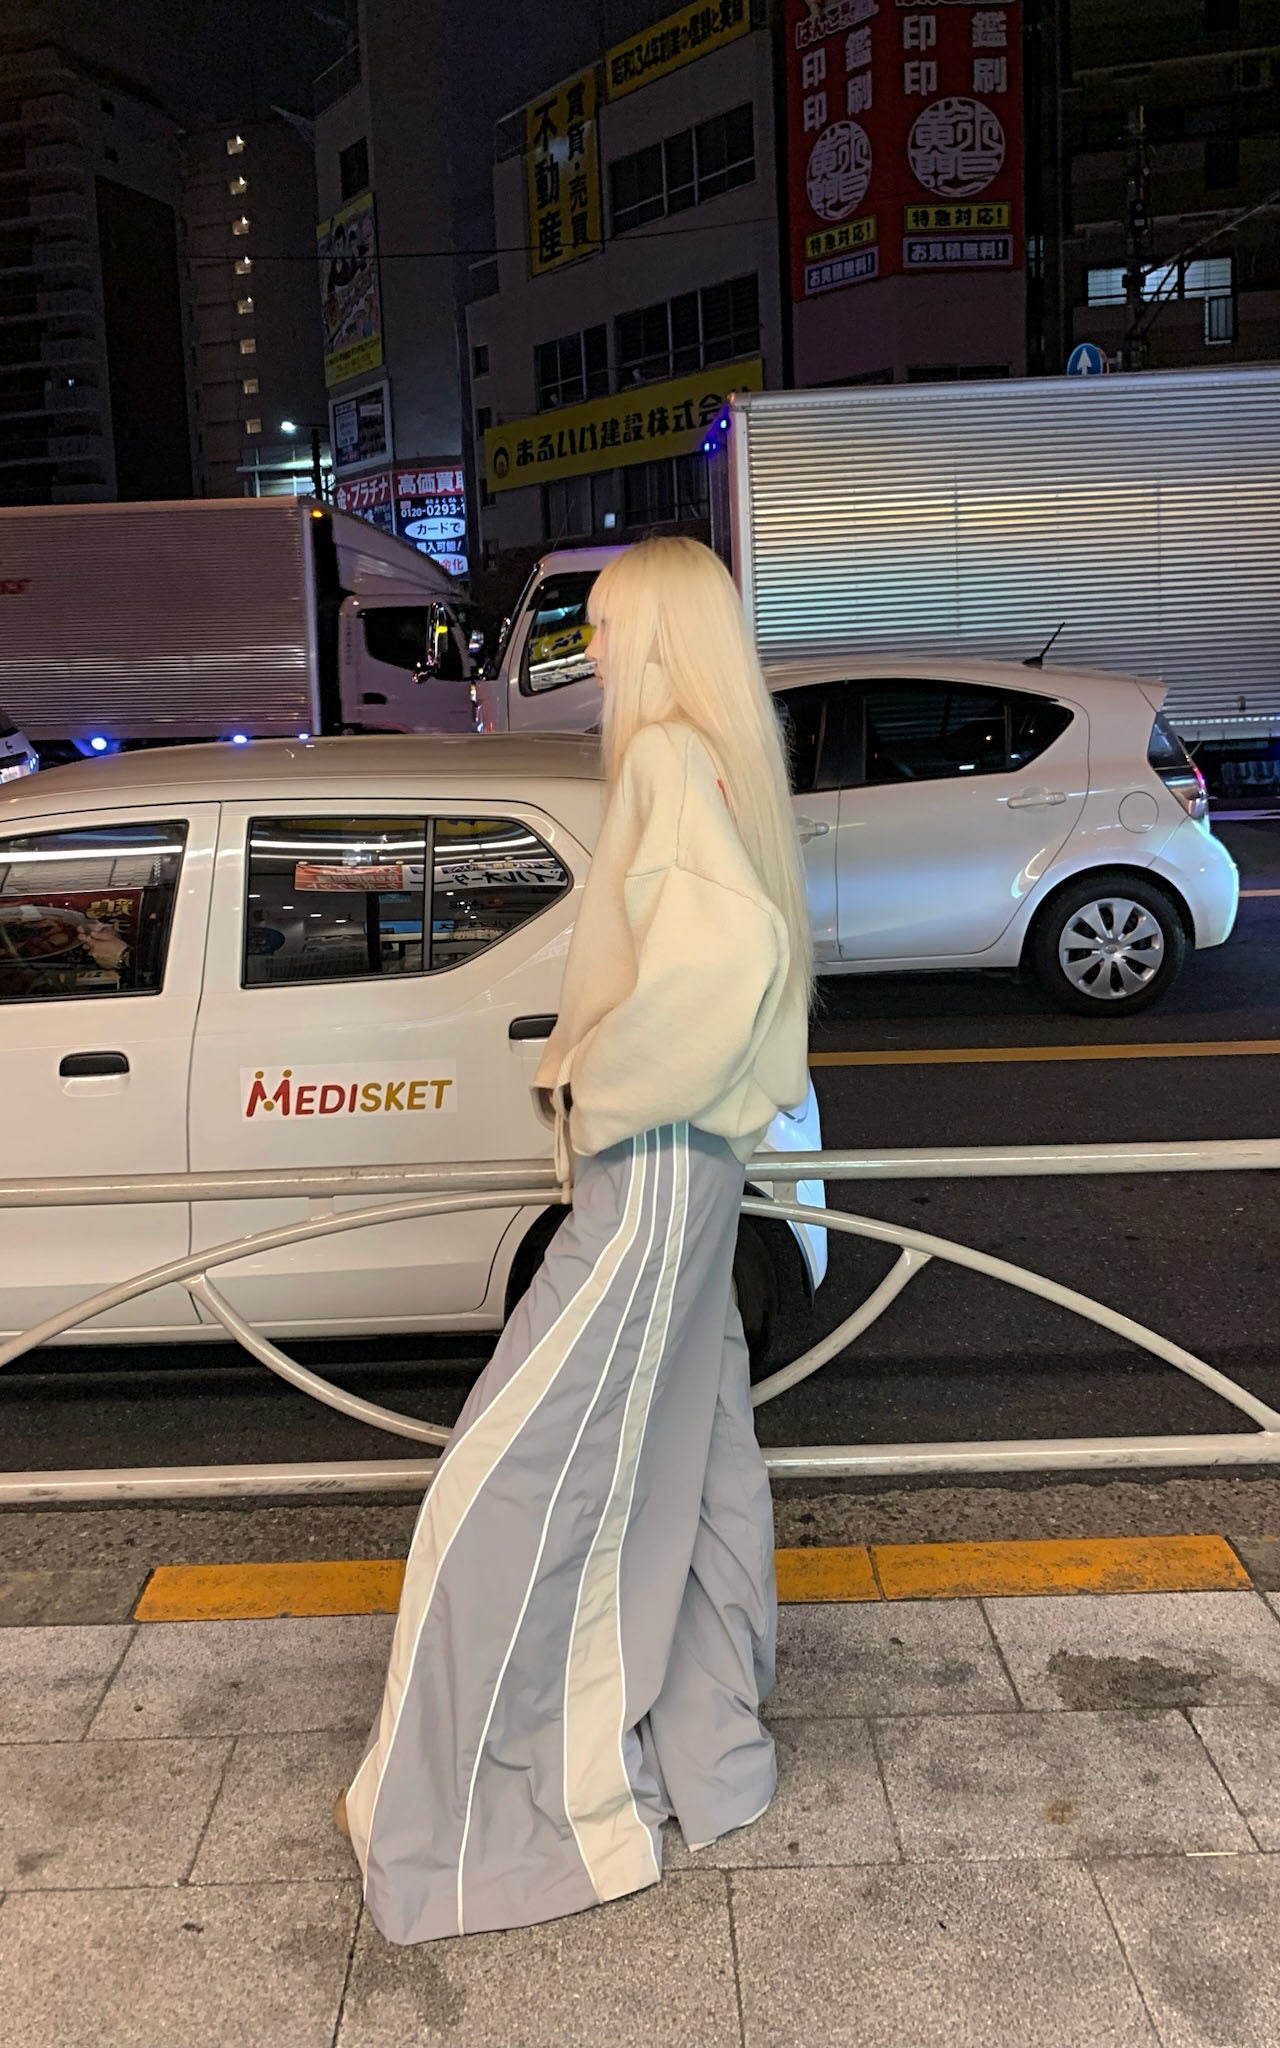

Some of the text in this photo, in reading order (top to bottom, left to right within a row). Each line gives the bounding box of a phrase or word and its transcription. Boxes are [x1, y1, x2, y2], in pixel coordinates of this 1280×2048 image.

[534, 96, 563, 264] 不動産
[567, 83, 588, 247] 賃貸・売買
[912, 207, 1003, 227] 特急対応!
[810, 221, 872, 254] 特急対応!
[910, 239, 1004, 262] お見積無料!
[517, 386, 748, 467] まるいけ建設株式会
[417, 521, 461, 536] カードで
[441, 558, 464, 571] 金化
[245, 1069, 453, 1118] MEDISKET
